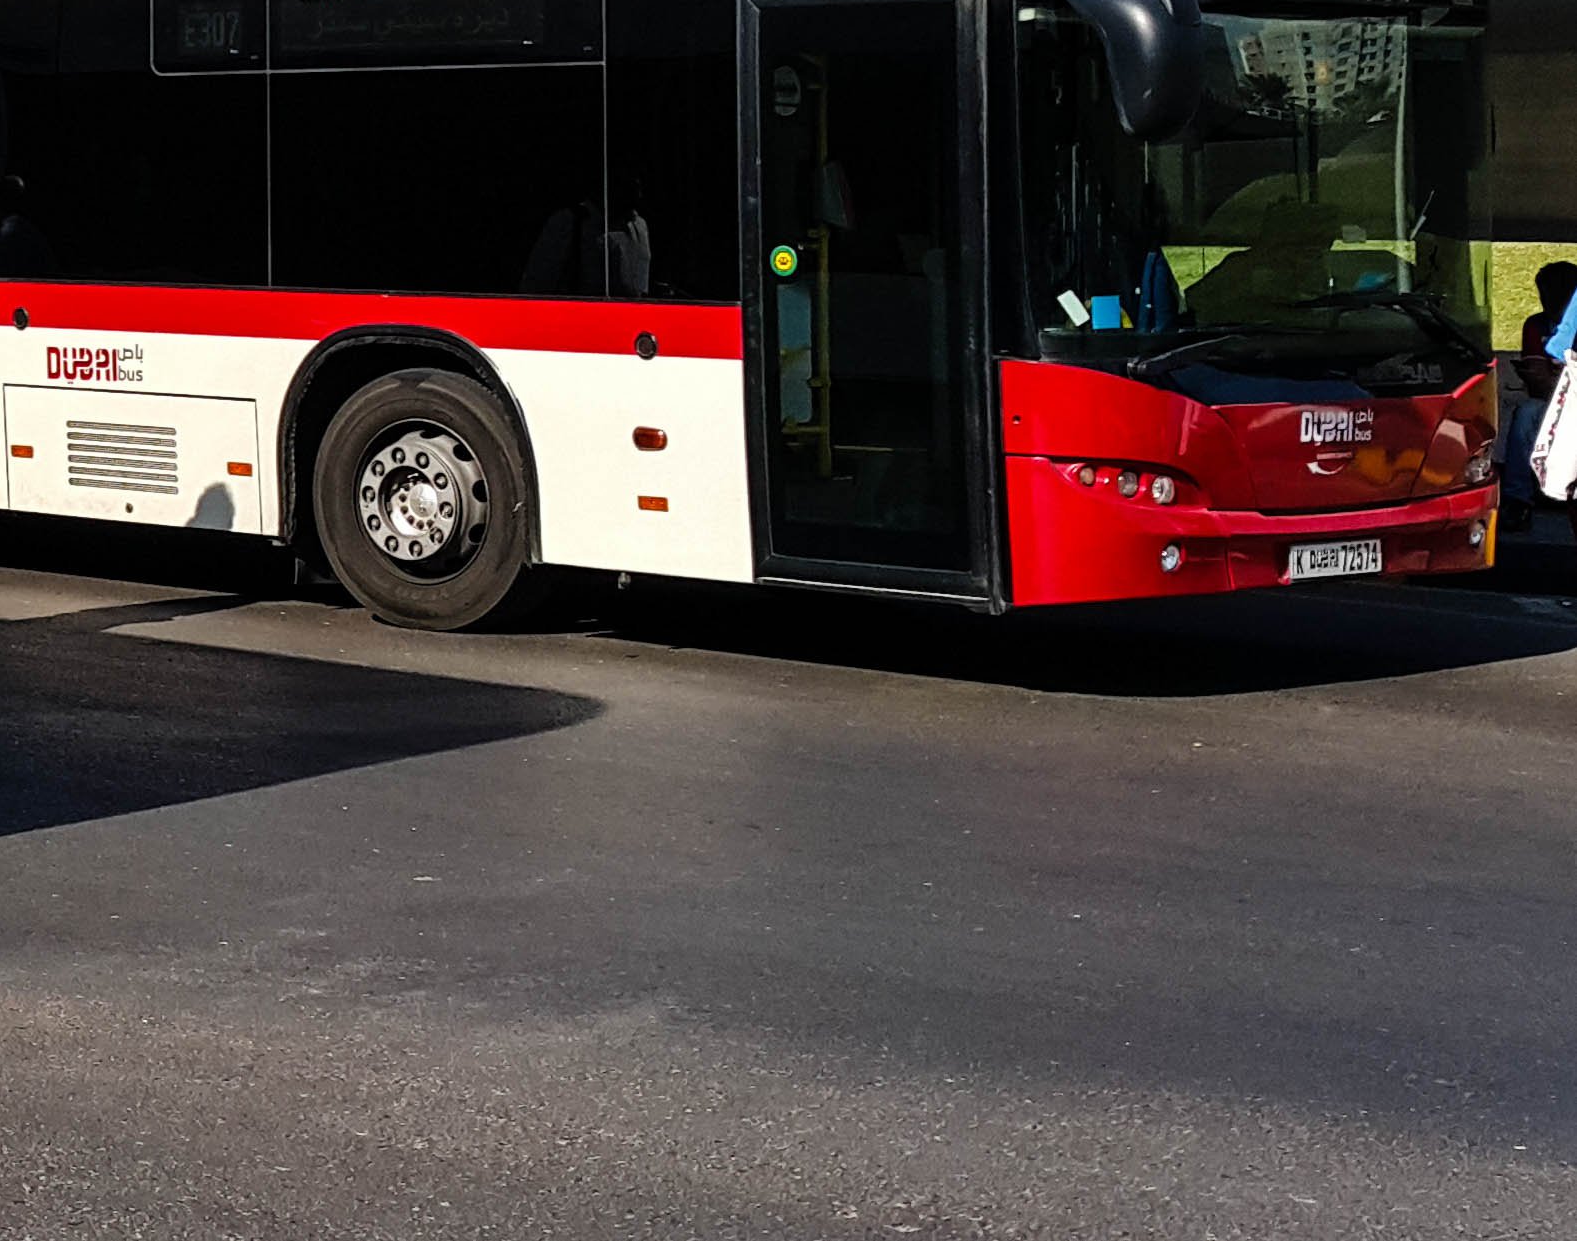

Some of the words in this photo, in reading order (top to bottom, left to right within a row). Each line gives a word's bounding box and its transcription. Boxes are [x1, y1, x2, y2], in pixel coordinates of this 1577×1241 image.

[47, 347, 117, 384] DUBAI
[117, 344, 143, 363] باص
[118, 366, 143, 381] bus
[1300, 411, 1354, 446] DUBAI
[1355, 428, 1372, 441] bus
[1296, 549, 1304, 574] K
[1341, 542, 1378, 572] 72574
